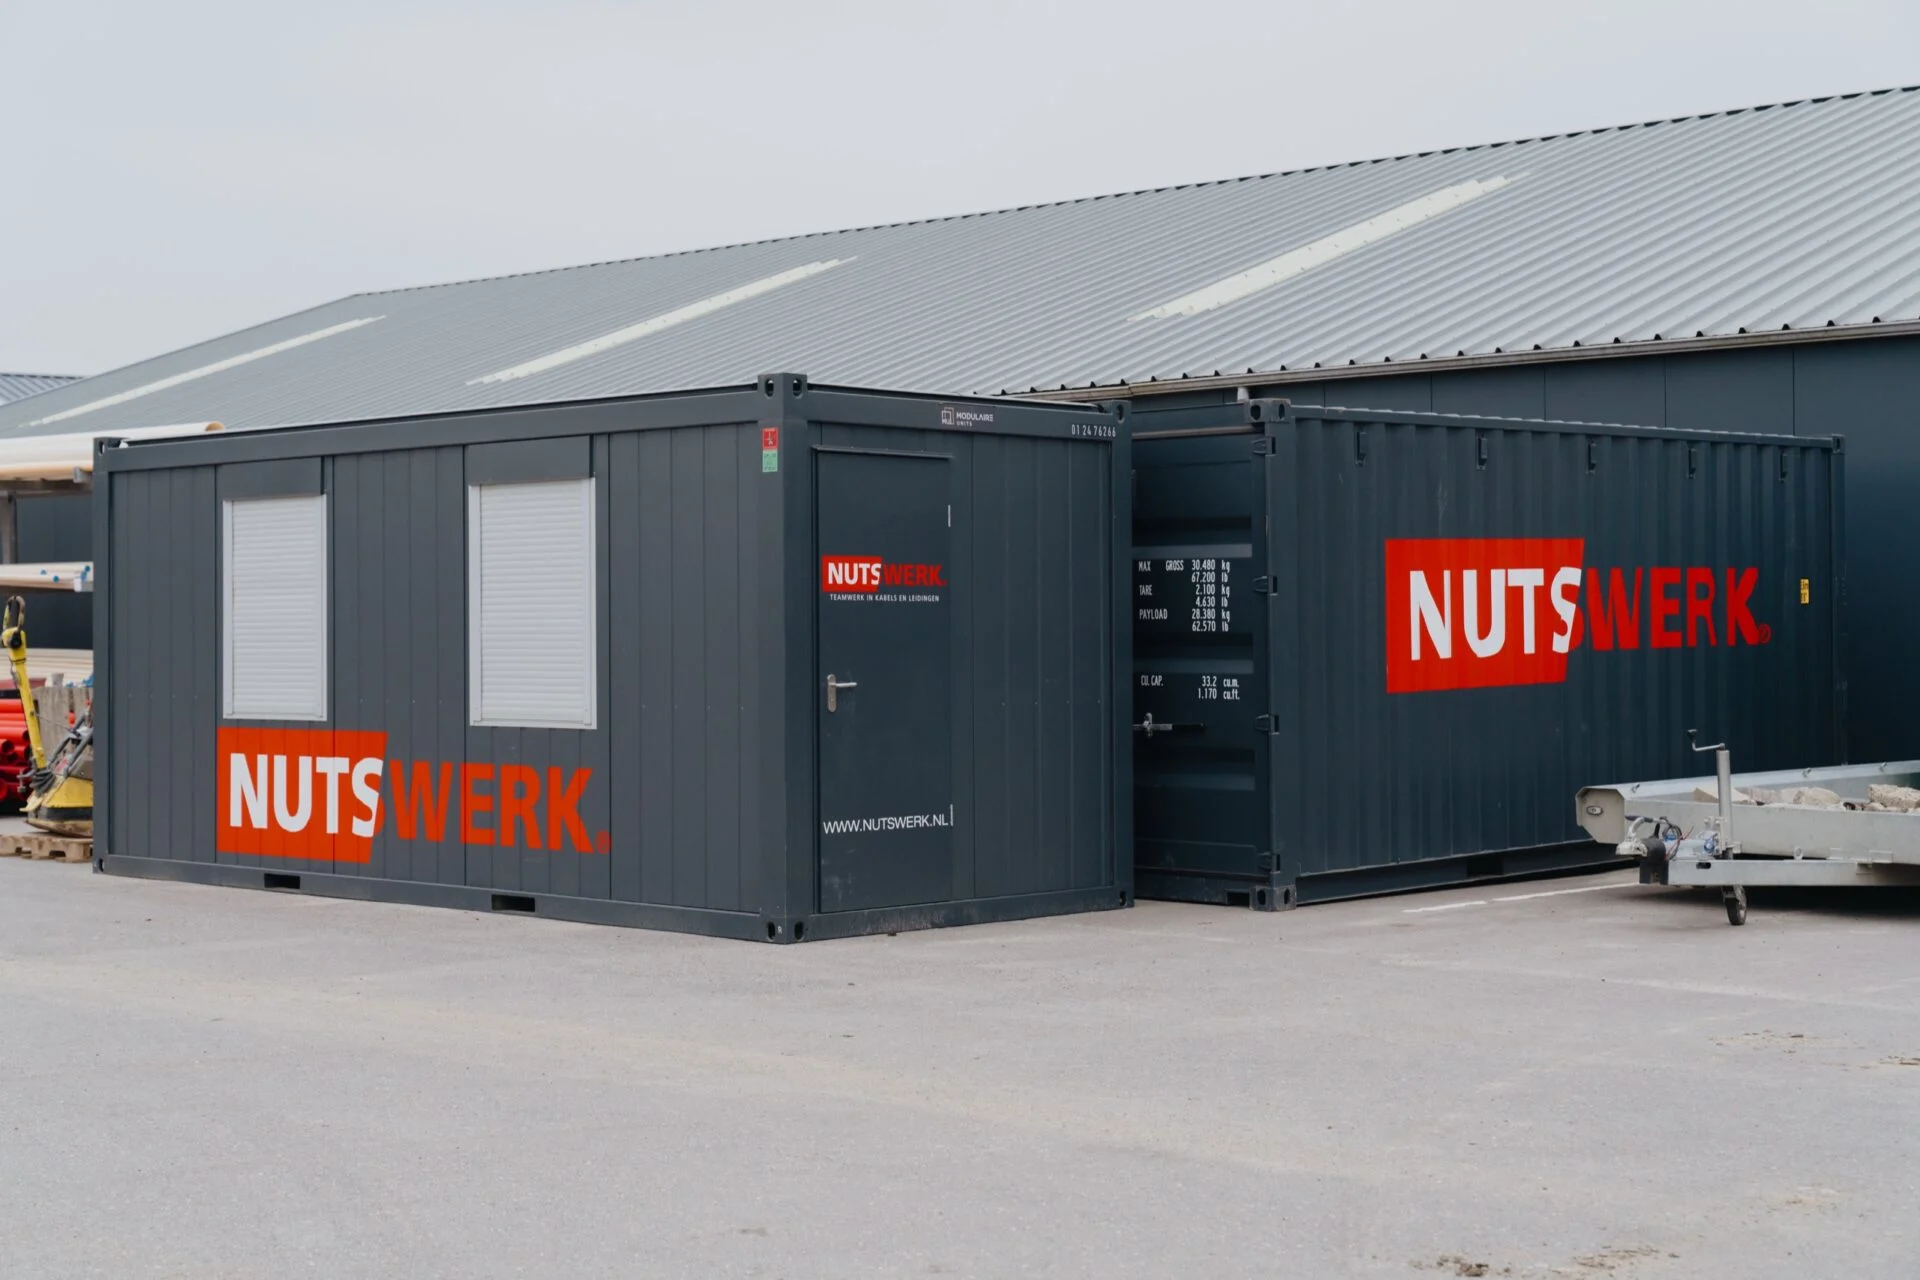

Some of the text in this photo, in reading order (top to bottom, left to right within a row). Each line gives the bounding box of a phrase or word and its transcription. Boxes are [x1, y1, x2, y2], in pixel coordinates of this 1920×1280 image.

[956, 411, 994, 422] MODULAIRE
[1138, 559, 1230, 573] MAX GROSS 30.480 kg
[1191, 571, 1229, 583] 67.200 lb
[1139, 584, 1230, 598] TARE 2.100 kg
[829, 593, 865, 601] TEAMWERK
[875, 594, 897, 602] KABELS
[898, 594, 907, 602] EN
[1195, 596, 1229, 607] 4.630 lb
[1139, 608, 1230, 623] PAYLOAD 28.380 kg
[1192, 621, 1229, 632] 62.570 lb
[1150, 674, 1164, 686] CAP.
[1201, 675, 1217, 687] 33.2
[1198, 687, 1217, 699] 1.170
[823, 813, 949, 835] WWW.NUTSWERK.NL
